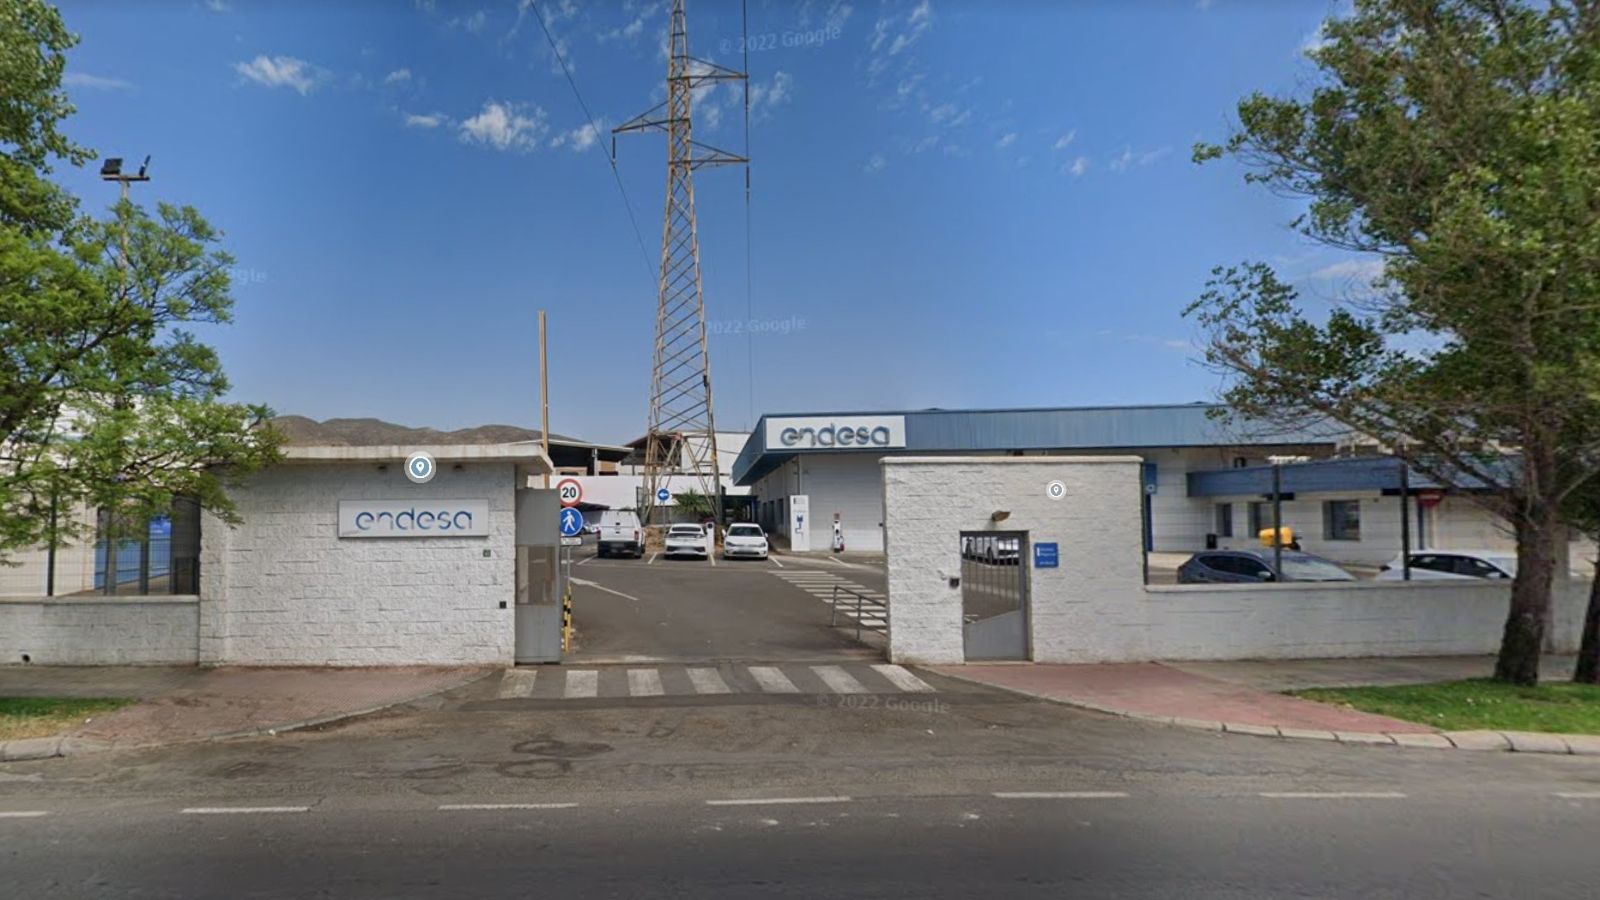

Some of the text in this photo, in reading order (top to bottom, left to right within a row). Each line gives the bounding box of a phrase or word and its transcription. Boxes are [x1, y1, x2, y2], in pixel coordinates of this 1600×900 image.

[780, 422, 890, 447] endesa
[562, 486, 577, 498] 20
[355, 508, 473, 530] endesa
